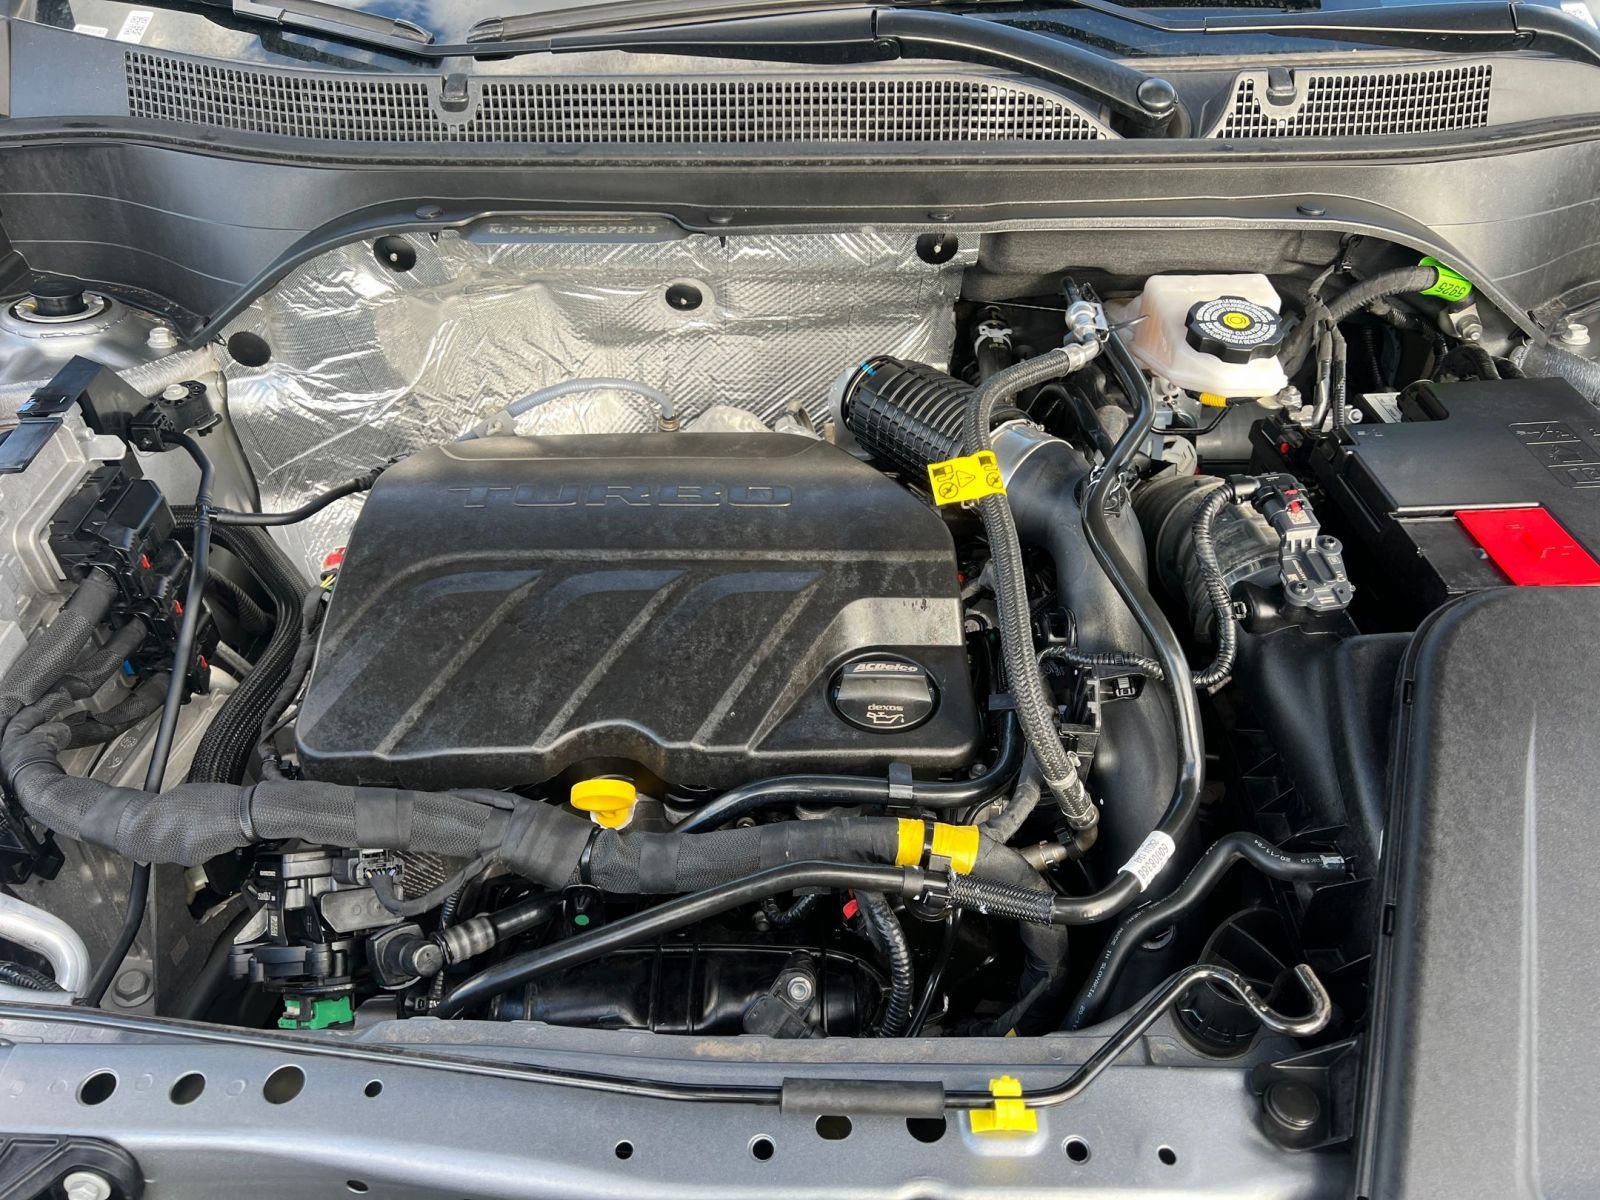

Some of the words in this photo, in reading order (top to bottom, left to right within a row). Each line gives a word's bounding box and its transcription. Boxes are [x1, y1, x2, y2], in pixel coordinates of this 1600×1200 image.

[447, 484, 794, 508] TURBO
[853, 663, 918, 672] ACDelco
[867, 703, 905, 711] dexos
